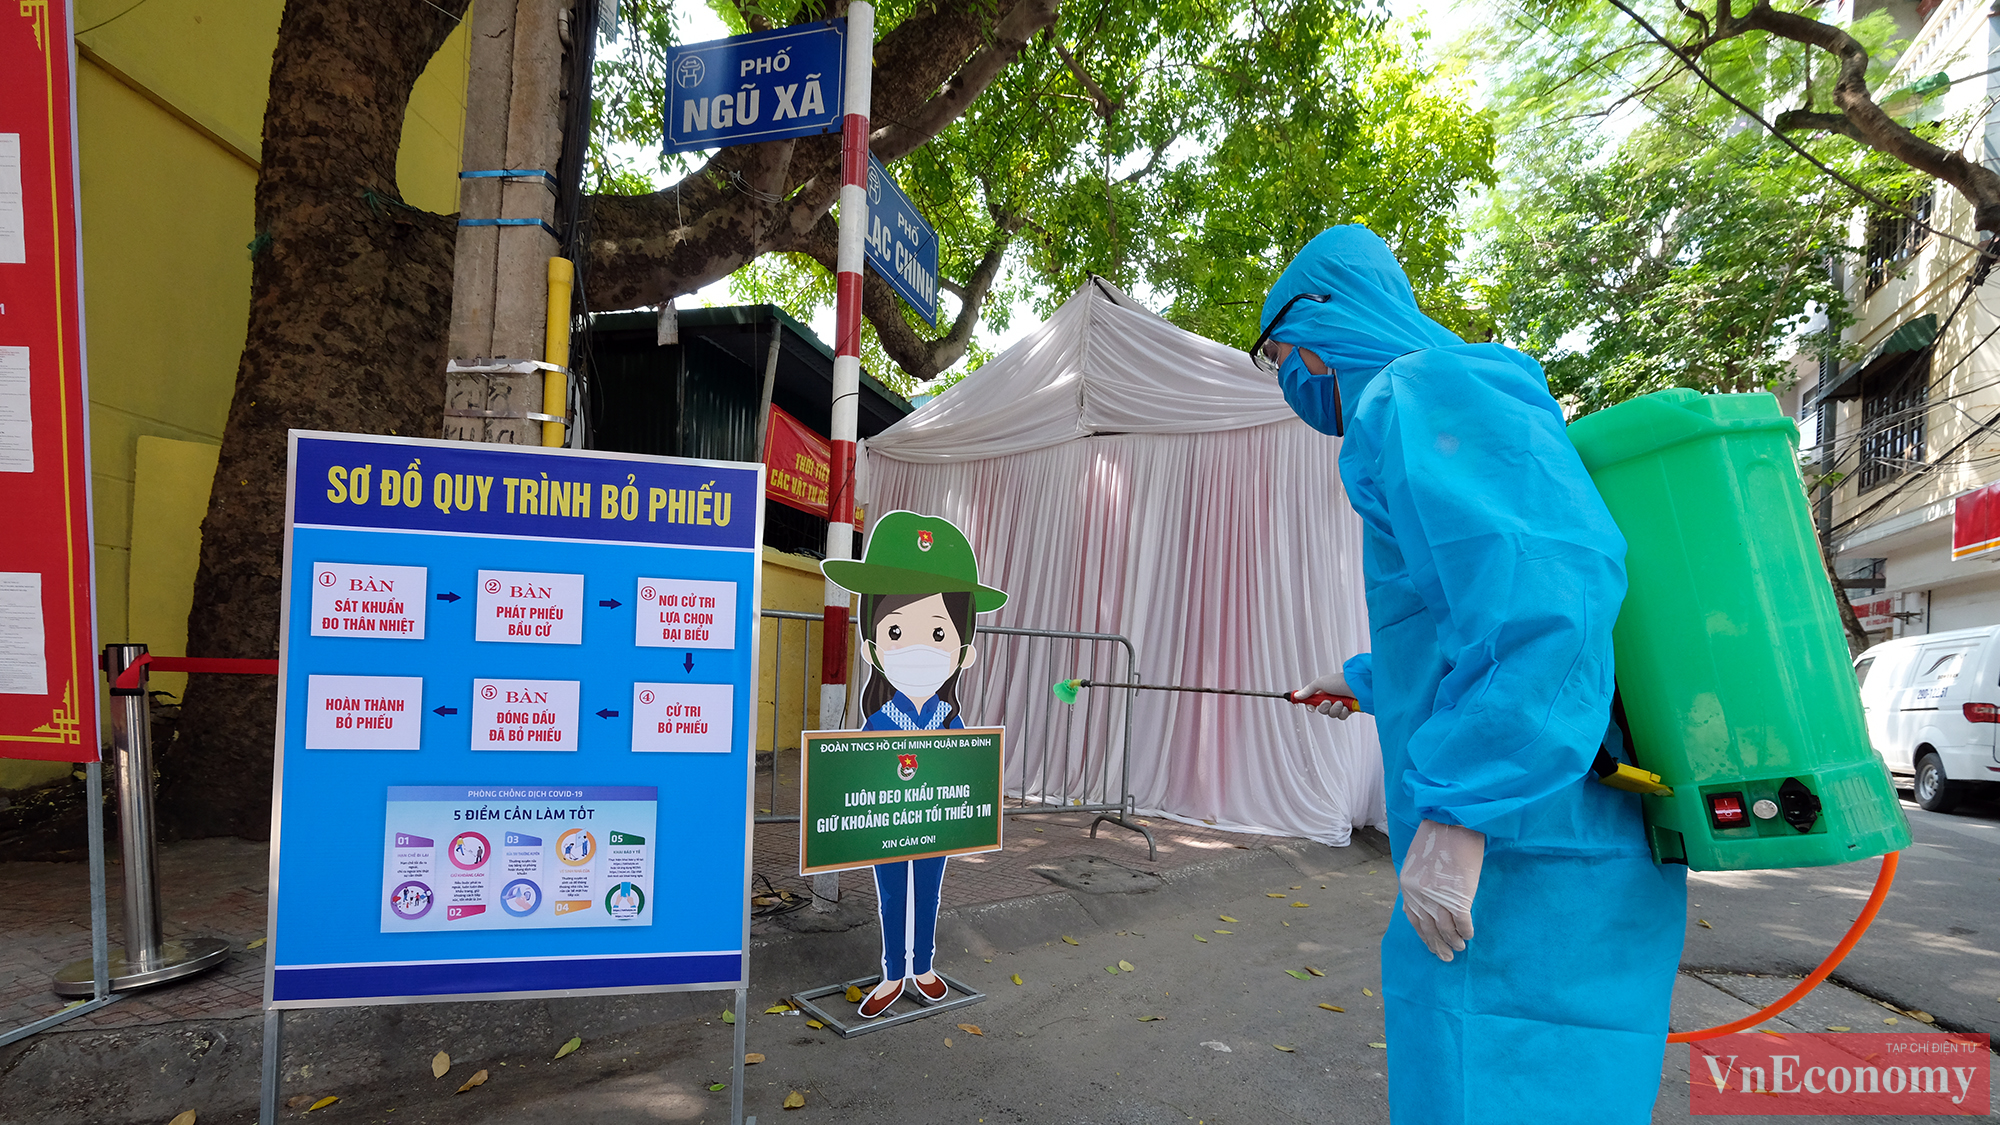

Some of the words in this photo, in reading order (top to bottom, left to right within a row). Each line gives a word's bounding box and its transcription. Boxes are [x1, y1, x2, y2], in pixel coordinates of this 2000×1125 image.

[740, 46, 793, 77] PHỐ
[683, 82, 760, 134] NGŨ
[772, 72, 825, 121] XÃ
[898, 211, 919, 246] PHỐ
[864, 204, 892, 262] LẠC
[895, 240, 933, 307] CHÍNH
[770, 469, 790, 491] CÁC
[792, 477, 807, 499] VẬT
[327, 465, 372, 505] SƠ
[380, 458, 423, 508] ĐỒ
[434, 473, 494, 514] QUY
[503, 472, 591, 518] TRÌNH
[601, 474, 639, 521] BỎ
[649, 481, 731, 527] PHIẾU
[349, 576, 394, 592] BÀN
[510, 583, 552, 599] BÀN
[335, 598, 358, 612] SÁT
[362, 597, 404, 614] KHUẨN
[659, 595, 678, 606] NƠI
[681, 593, 697, 607] CỬ
[699, 597, 715, 608] TRI
[496, 605, 526, 618] PHÁT
[530, 605, 563, 620] PHIẾU
[660, 612, 680, 625] LỰA
[684, 613, 713, 626] CHỌN
[322, 617, 339, 629] ĐO
[343, 616, 375, 631] THÂN
[379, 618, 415, 634] NHIỆT
[508, 621, 532, 636] BẦU
[535, 622, 552, 637] CỬ
[663, 629, 681, 642] ĐẠI
[685, 625, 709, 641] BIỂU
[506, 688, 548, 703] BÀN
[326, 696, 360, 711] HOÀN
[364, 697, 404, 711] THÀNH
[666, 702, 682, 716] CỬ
[685, 706, 700, 717] TRI
[336, 713, 352, 729] BỎ
[357, 714, 393, 729] PHIẾU
[497, 710, 529, 724] ĐÓNG
[533, 709, 555, 724] DẤU
[489, 728, 504, 741] ĐÃ
[509, 726, 524, 741] BỎ
[528, 727, 561, 742] PHIẾU
[658, 719, 672, 733] BỎ
[676, 719, 708, 734] PHIẾU
[820, 741, 849, 752] ĐOÀN
[851, 742, 874, 751] TNCS
[877, 739, 890, 751] HỒ
[892, 739, 907, 750] CHÍ
[909, 740, 932, 749] MINH
[934, 738, 957, 750] QUẬN
[960, 739, 970, 747] BA
[971, 737, 991, 747] ĐÌNH
[468, 788, 496, 797] PHÒNG
[499, 788, 526, 798] CHỐNG
[528, 790, 546, 798] DỊCH
[549, 790, 583, 798] COVID-19
[845, 789, 876, 807] LUÔN
[879, 789, 901, 804] ĐEO
[905, 782, 934, 802] KHẨU
[937, 784, 970, 799] TRANG
[454, 810, 461, 820] 5
[465, 805, 499, 820] ĐIỂM
[504, 805, 532, 820] CẦN
[536, 807, 565, 819] LÀM
[569, 805, 595, 819] TỐT
[816, 816, 840, 833] GIỮ
[841, 809, 890, 831] KHOẢNG
[893, 808, 922, 826] CÁCH
[926, 804, 942, 822] TỐI
[945, 800, 973, 821] THIỂU
[976, 804, 991, 817] 1M
[398, 837, 409, 845] 01
[507, 836, 519, 844] 03
[611, 835, 623, 843] 05
[882, 840, 897, 849] XIN
[899, 836, 918, 847] CẢM
[920, 835, 936, 844] ƠN!
[449, 908, 462, 916] 02
[556, 903, 569, 912] 04
